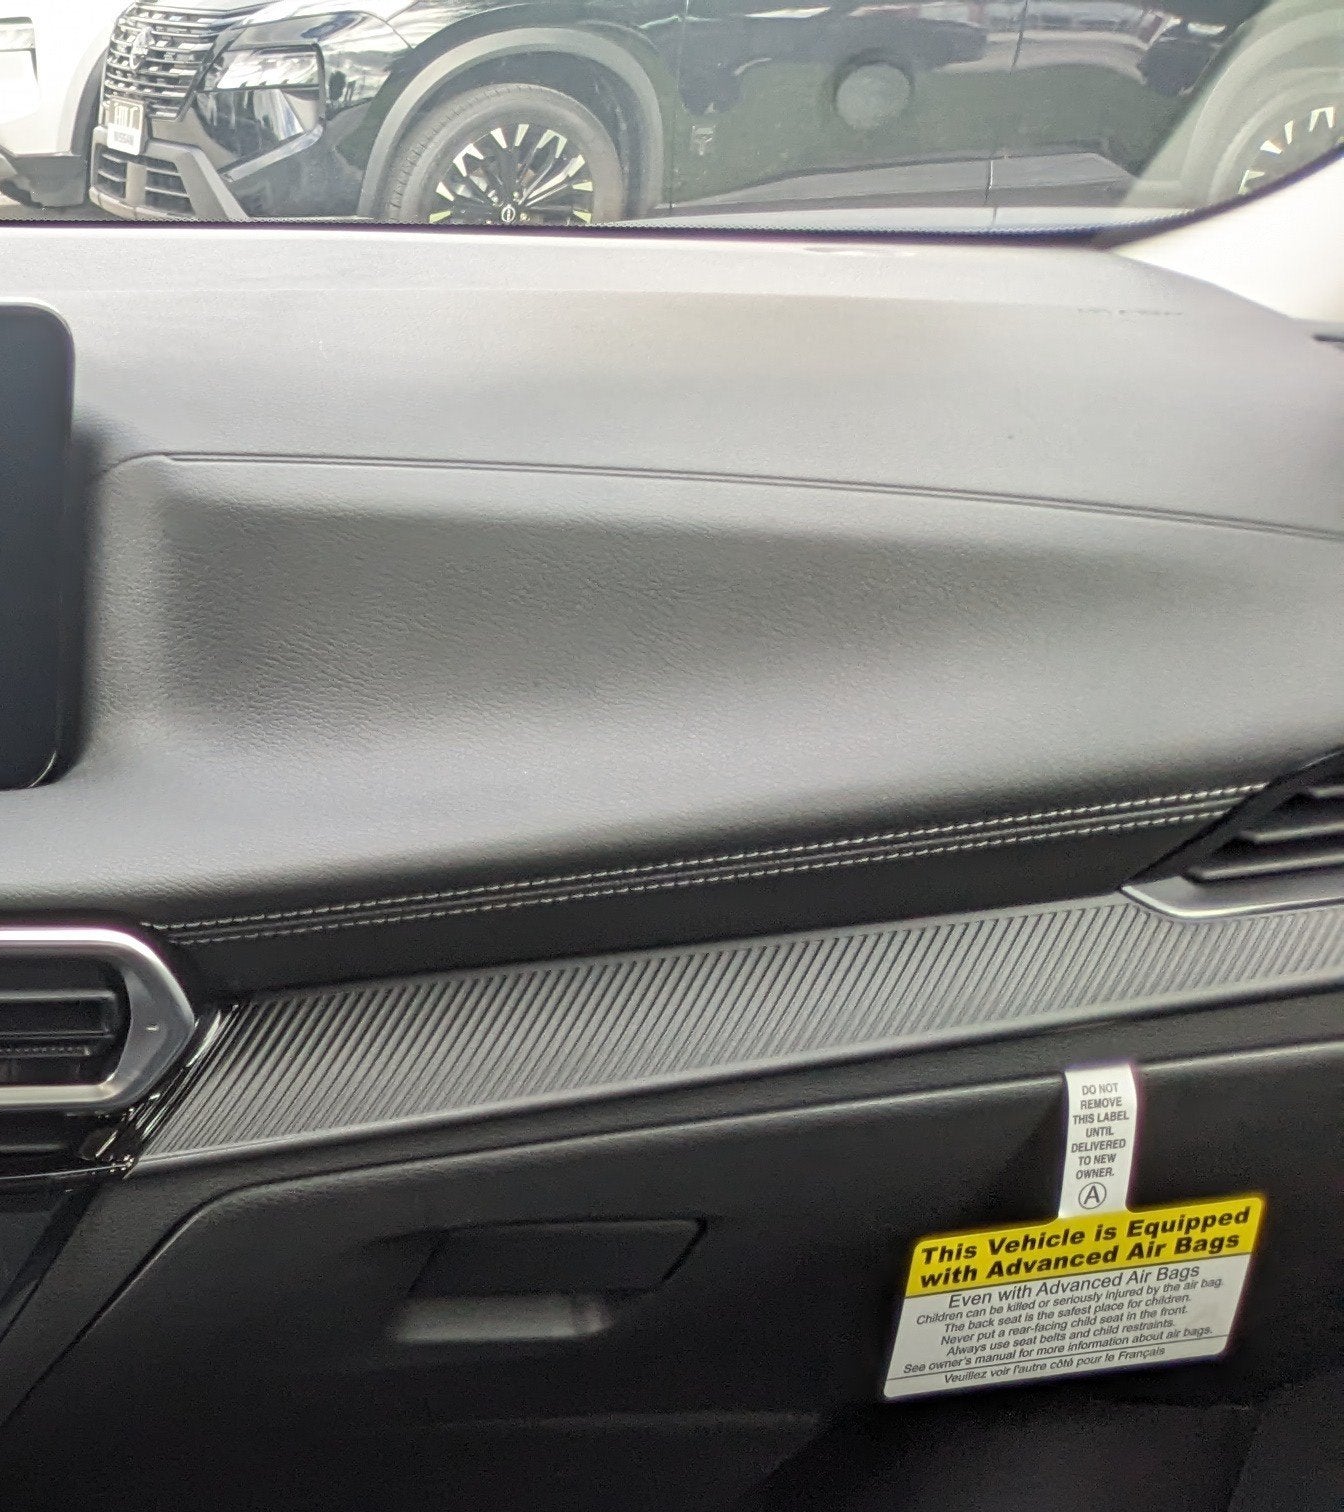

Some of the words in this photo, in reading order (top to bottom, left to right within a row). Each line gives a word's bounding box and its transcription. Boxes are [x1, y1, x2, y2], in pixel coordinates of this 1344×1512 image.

[1081, 1097, 1122, 1110] REMOVE
[1082, 1085, 1096, 1095] DO
[1099, 1083, 1118, 1093] NOT
[1073, 1114, 1094, 1125] THIS
[1097, 1110, 1129, 1123] LABEL
[1086, 1126, 1114, 1138] UNTIL
[1071, 1139, 1126, 1153] DELIVERED
[1078, 1155, 1091, 1166] TO
[1094, 1154, 1116, 1164] NEW
[1076, 1168, 1114, 1180] OWNER.
[1084, 1186, 1100, 1204] A
[922, 1243, 977, 1264] This
[988, 1229, 1085, 1255] Vehicle
[1094, 1224, 1117, 1241] is
[1126, 1206, 1250, 1239] Equipped
[921, 1265, 977, 1288] with
[986, 1245, 1119, 1279] Advanced
[1126, 1241, 1167, 1260] Air
[1174, 1234, 1239, 1254] Bags
[917, 1312, 962, 1325] Children
[966, 1310, 986, 1319] can
[990, 1305, 1004, 1314] be
[1007, 1300, 1035, 1312] killed
[1038, 1300, 1049, 1308] or
[1053, 1292, 1102, 1306] seriously
[1105, 1286, 1143, 1300] injured
[1146, 1285, 1159, 1296] by
[1163, 1282, 1180, 1292] the
[1183, 1280, 1197, 1290] air
[1201, 1278, 1224, 1289] bag.
[949, 1292, 992, 1308] Even
[998, 1285, 1032, 1303] with
[1036, 1272, 1123, 1296] Advanced
[1126, 1269, 1153, 1285] Air
[1156, 1265, 1200, 1282] Bags
[940, 1333, 974, 1345] Never
[977, 1329, 995, 1342] put
[998, 1329, 1005, 1337] a
[1008, 1321, 1068, 1335] rear-facing
[1071, 1316, 1097, 1328] child
[1099, 1313, 1123, 1324] seat
[1127, 1312, 1136, 1320] in
[1140, 1309, 1157, 1319] the
[1161, 1305, 1187, 1316] front.
[945, 1324, 964, 1332] The
[968, 1318, 994, 1330] back
[998, 1316, 1021, 1326] seat
[1025, 1313, 1033, 1321] is
[1037, 1310, 1054, 1319] the
[1058, 1305, 1091, 1318] safest
[1094, 1300, 1124, 1313] place
[1127, 1298, 1141, 1308] for
[1145, 1294, 1191, 1306] children.
[904, 1364, 926, 1374] See
[975, 1351, 1016, 1364] manual
[1019, 1348, 1033, 1358] for
[1037, 1345, 1065, 1355] more
[1068, 1338, 1129, 1351] information
[1132, 1332, 1162, 1344] about
[1166, 1329, 1181, 1339] air
[1184, 1326, 1213, 1338] bags.
[947, 1342, 986, 1356] Always
[990, 1340, 1009, 1350] use
[1013, 1336, 1037, 1346] seat
[1040, 1332, 1065, 1343] belts
[1069, 1329, 1090, 1339] and
[1093, 1324, 1118, 1335] child
[1122, 1319, 1175, 1332] restraints.
[944, 1371, 986, 1384] Veuillez
[990, 1367, 1009, 1377] voir
[1050, 1357, 1073, 1369] côté
[1076, 1356, 1102, 1368] pour
[1105, 1353, 1114, 1362] le
[1118, 1346, 1165, 1360] Français
